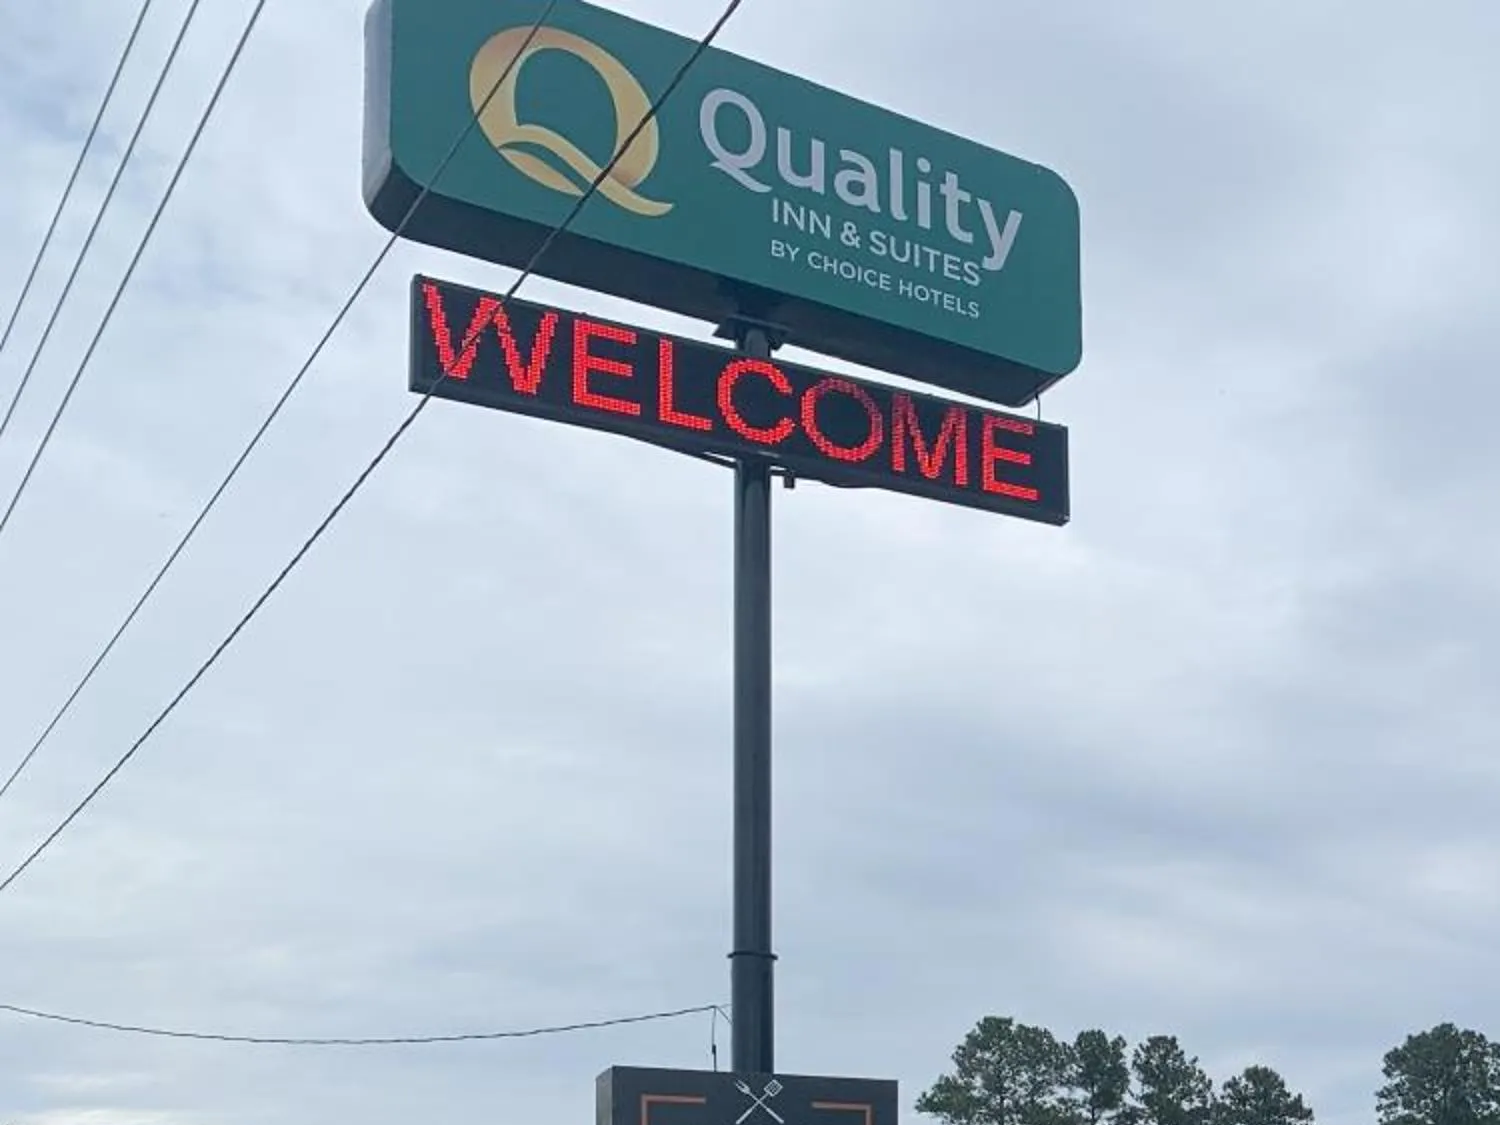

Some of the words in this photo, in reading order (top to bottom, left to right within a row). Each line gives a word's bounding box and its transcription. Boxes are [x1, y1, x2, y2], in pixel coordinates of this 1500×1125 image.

[699, 88, 1024, 271] Quality
[771, 197, 832, 240] INN
[840, 221, 862, 249] &
[868, 230, 982, 288] SUITES
[770, 239, 800, 263] BY
[806, 251, 893, 292] CHOICE
[898, 278, 981, 320] HOTELS
[421, 283, 1040, 501] WELCOME
